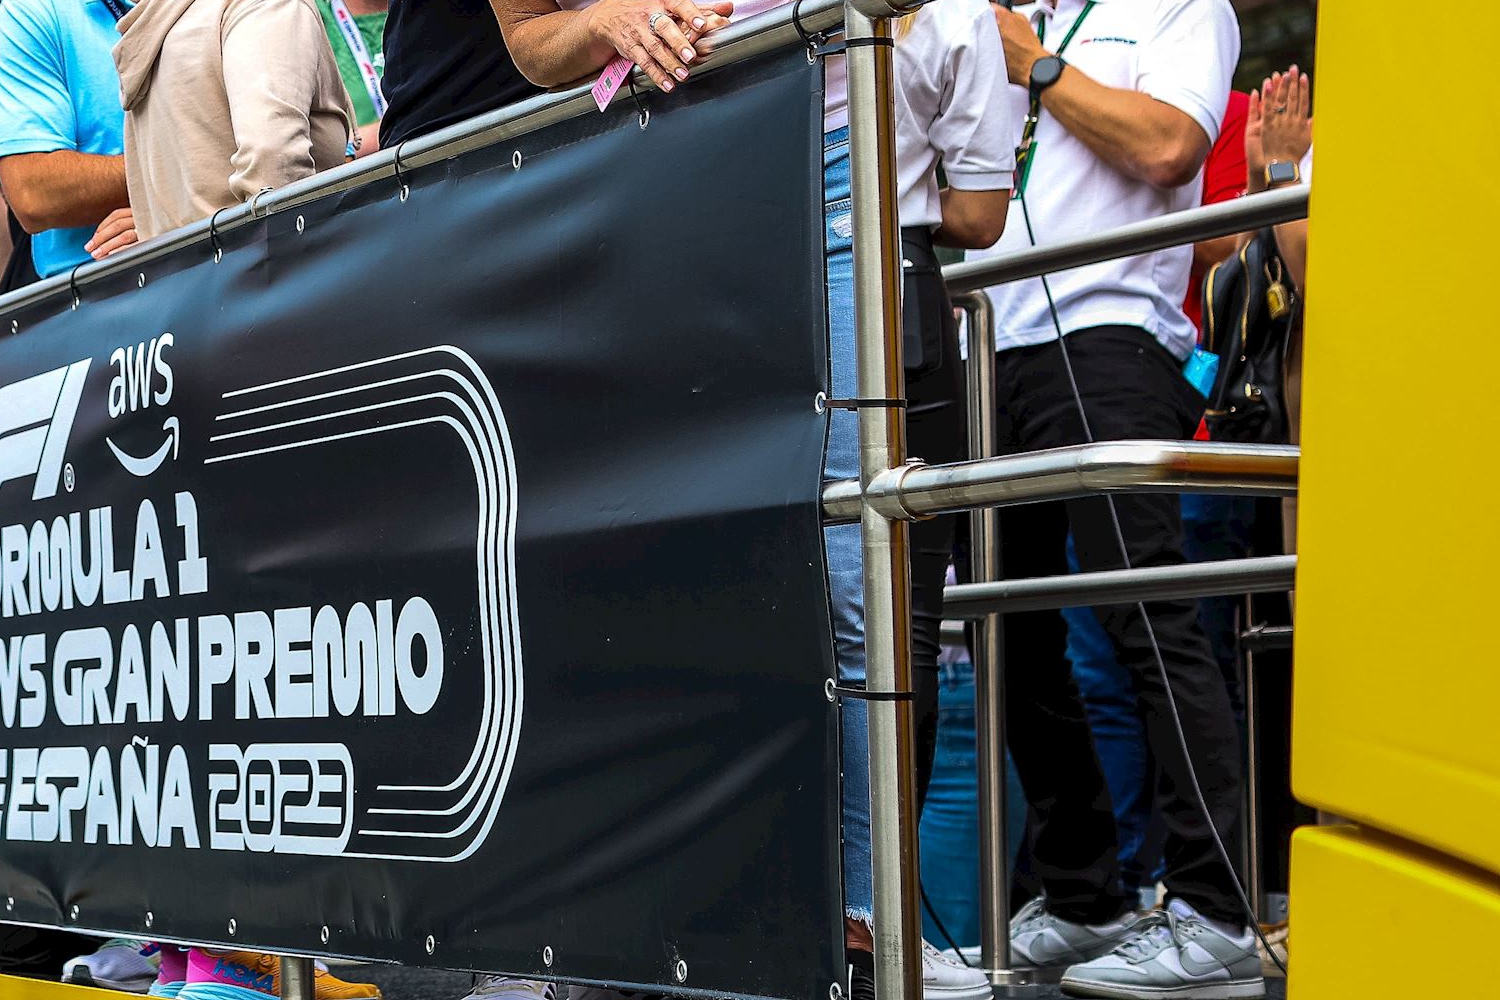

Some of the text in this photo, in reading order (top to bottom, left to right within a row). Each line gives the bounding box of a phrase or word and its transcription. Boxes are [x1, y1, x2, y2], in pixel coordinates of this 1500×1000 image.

[108, 332, 174, 418] aws
[174, 490, 209, 596] 1
[53, 617, 191, 726] GRAN
[198, 596, 445, 722] PREMIO
[6, 735, 201, 849] ESPAÑA
[208, 742, 355, 854] 2023
[213, 957, 275, 991] HOKA
